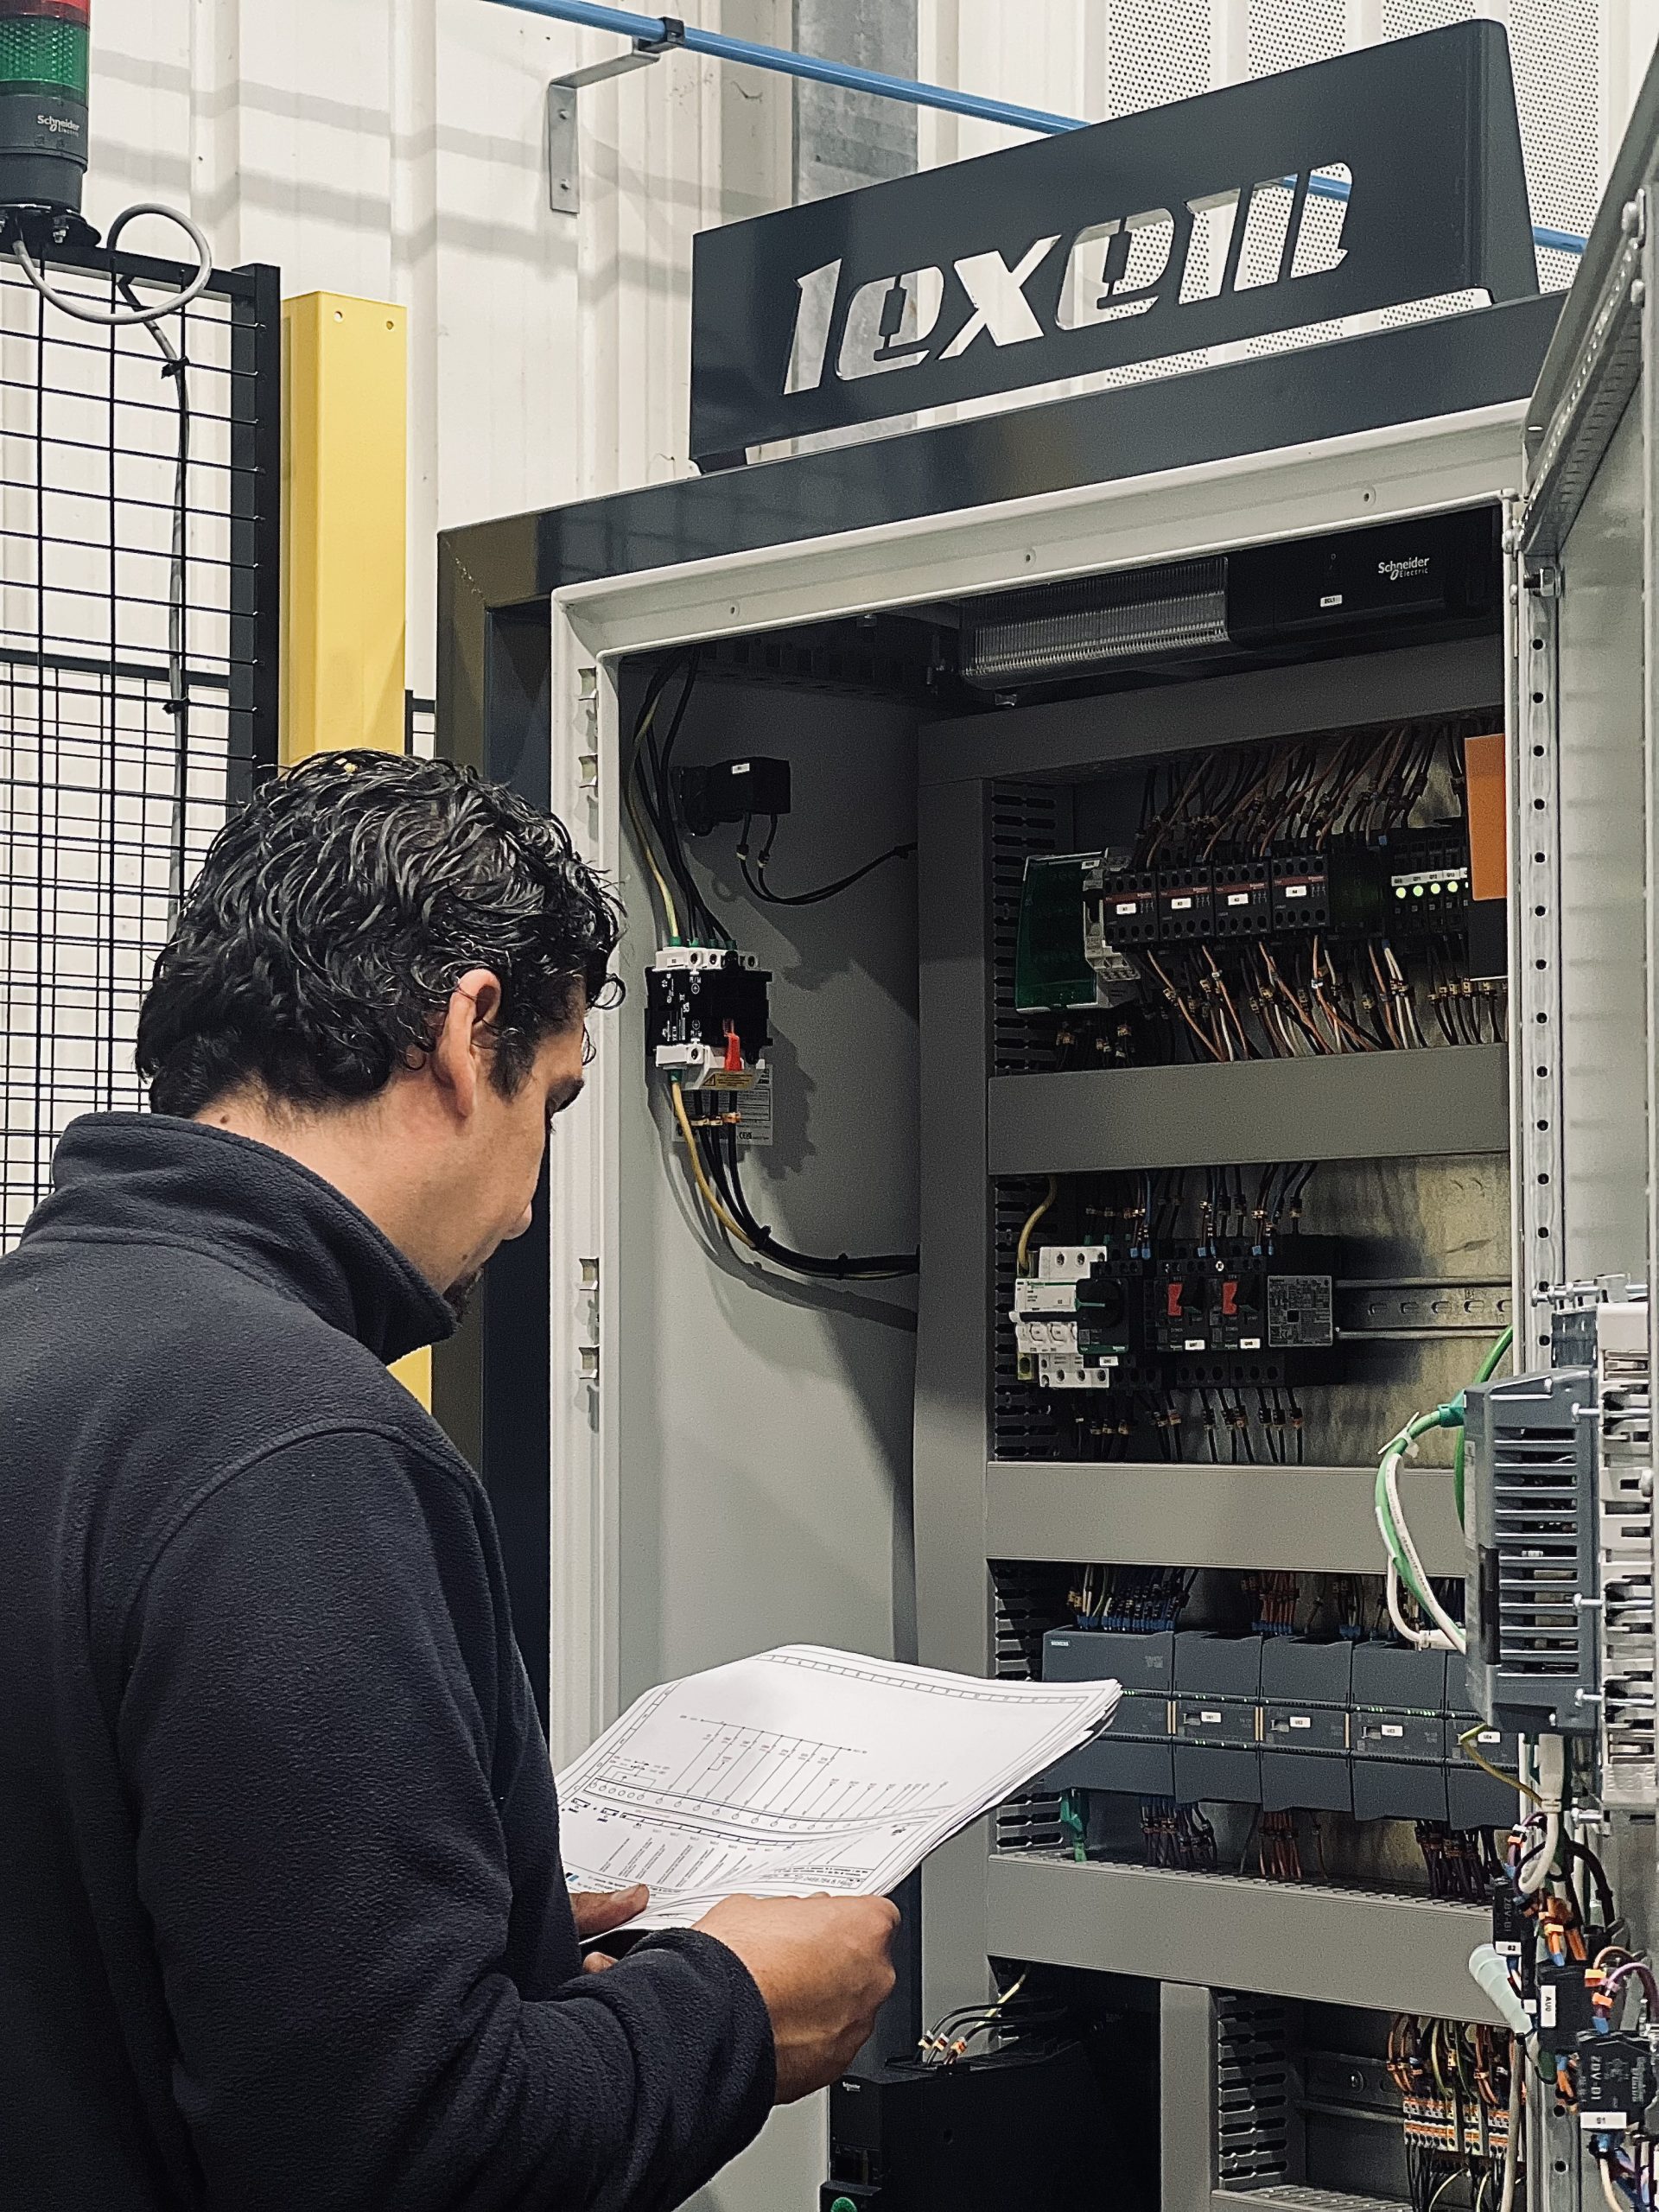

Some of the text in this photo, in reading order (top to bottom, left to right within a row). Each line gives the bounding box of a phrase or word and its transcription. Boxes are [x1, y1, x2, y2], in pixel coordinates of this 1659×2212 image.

[37, 115, 79, 130] Schneider
[1377, 556, 1430, 574] Schneider
[1399, 568, 1428, 577] Electric
